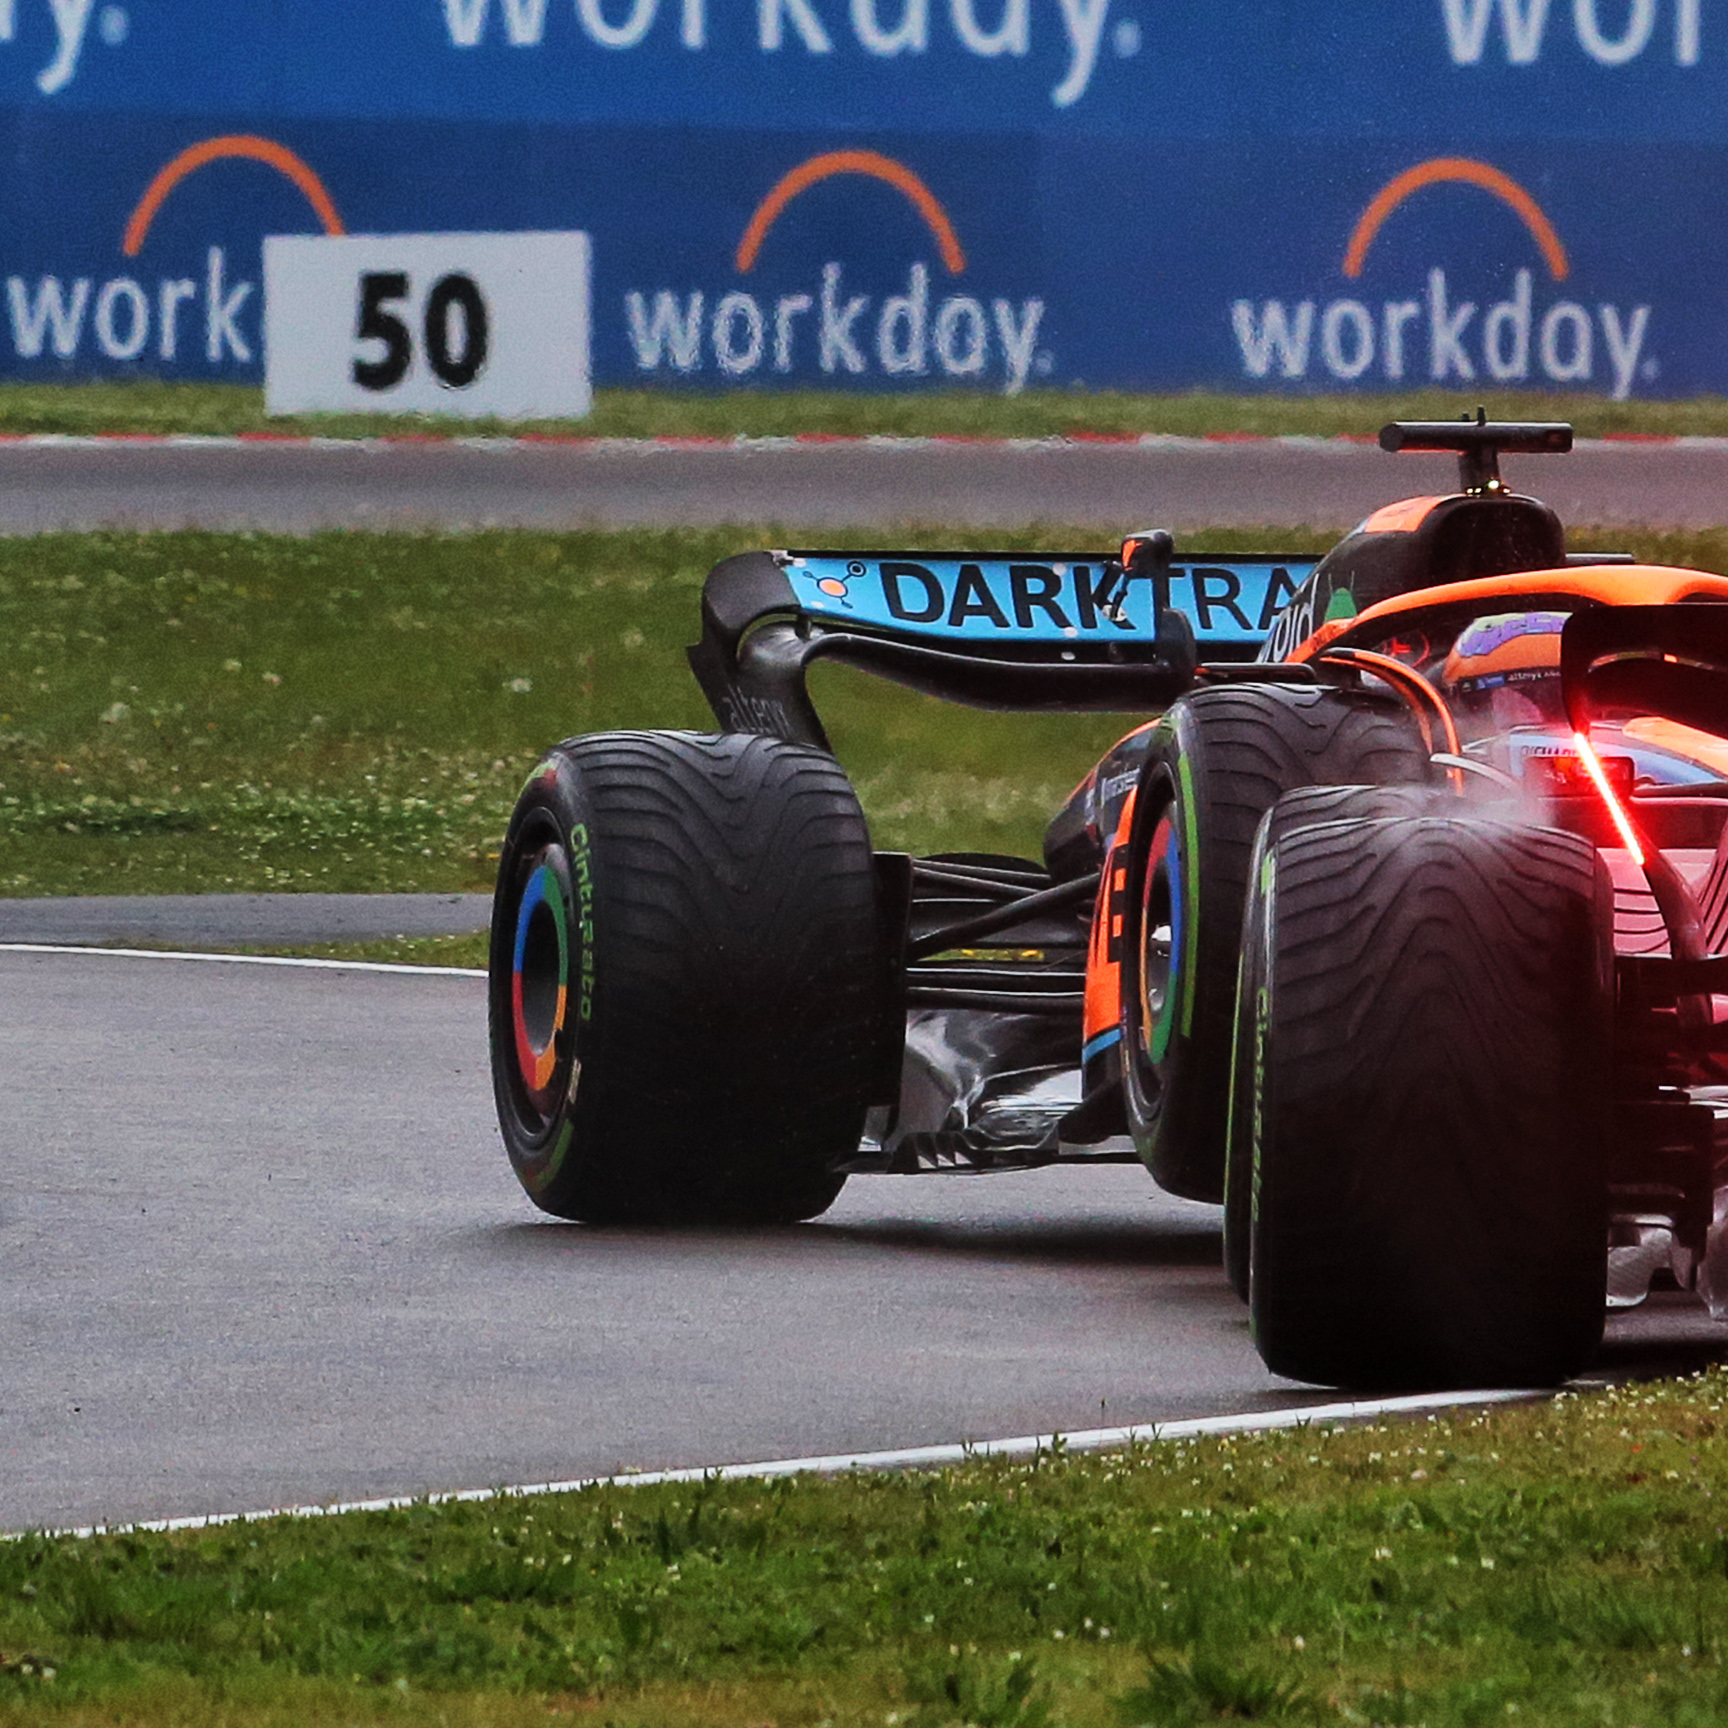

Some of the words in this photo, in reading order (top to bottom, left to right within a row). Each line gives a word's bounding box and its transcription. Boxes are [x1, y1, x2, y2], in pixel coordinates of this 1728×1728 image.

[6, 247, 254, 362] work
[352, 272, 489, 391] 50
[626, 263, 1045, 397] workday
[1231, 268, 1651, 401] workday
